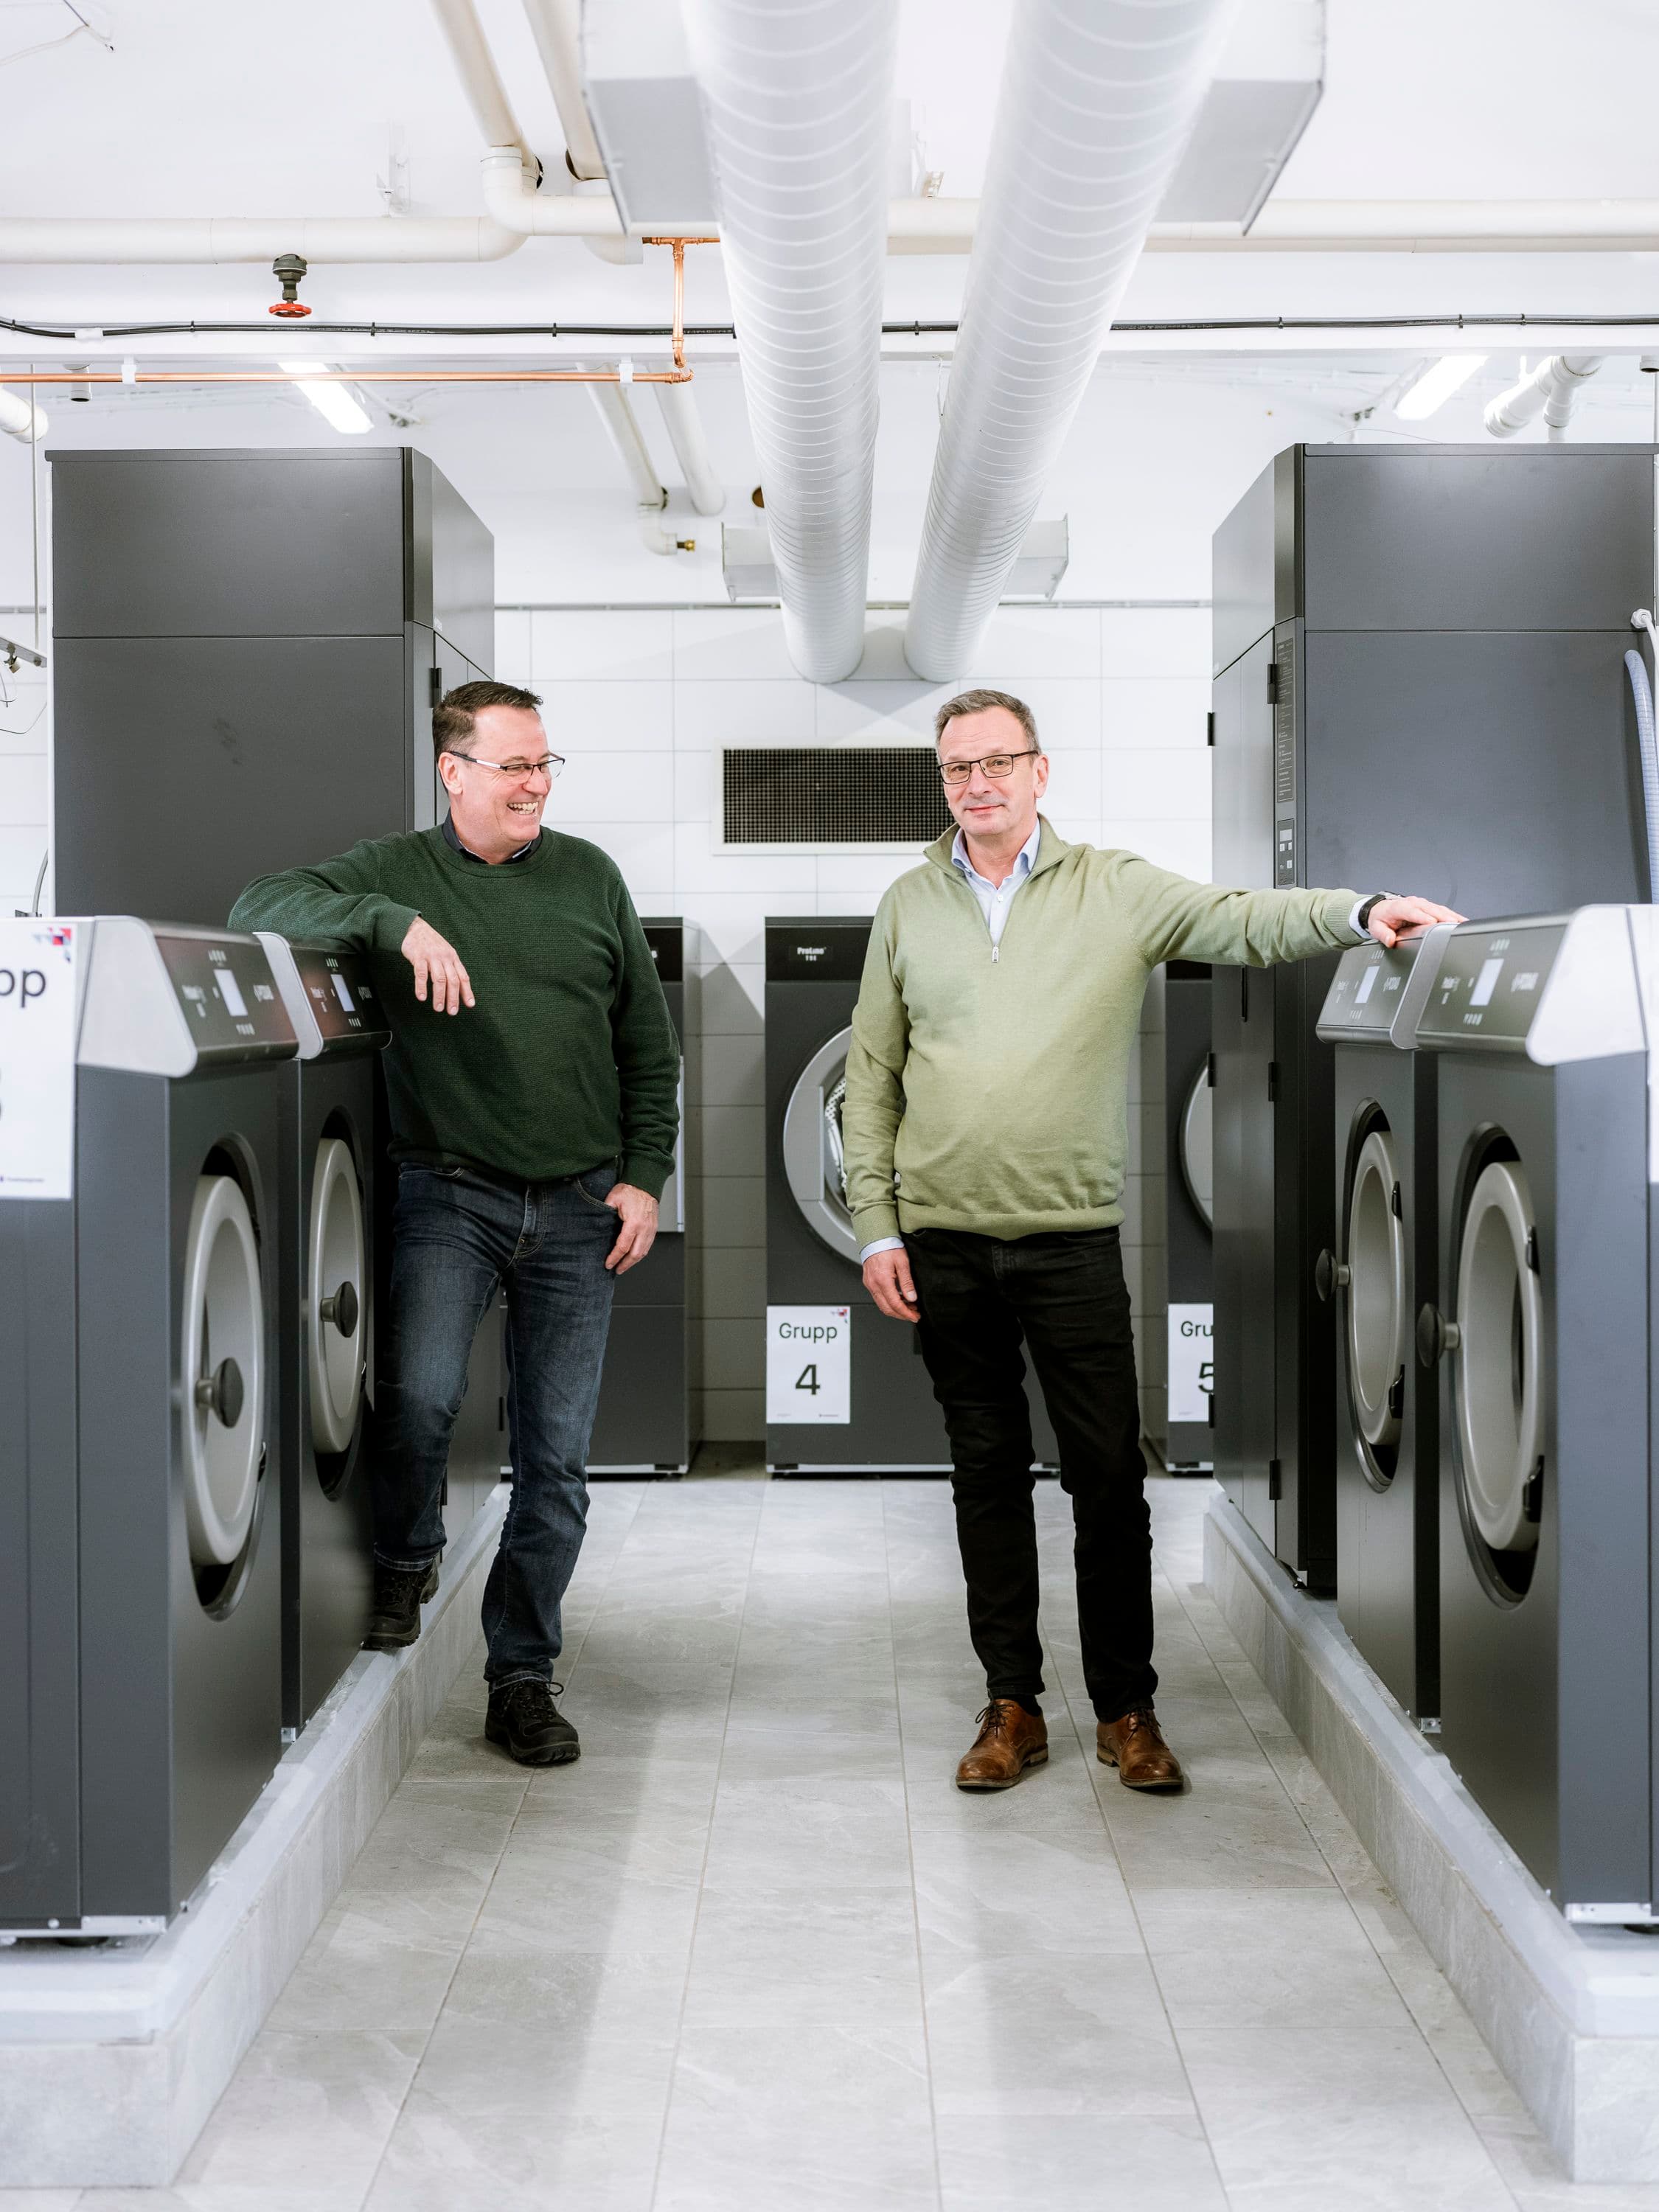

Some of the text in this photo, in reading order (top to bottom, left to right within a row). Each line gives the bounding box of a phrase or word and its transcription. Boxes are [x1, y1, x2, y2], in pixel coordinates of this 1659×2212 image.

[779, 1322, 838, 1343] Grupp
[795, 1364, 821, 1396] 4
[1198, 1362, 1214, 1394] 5
